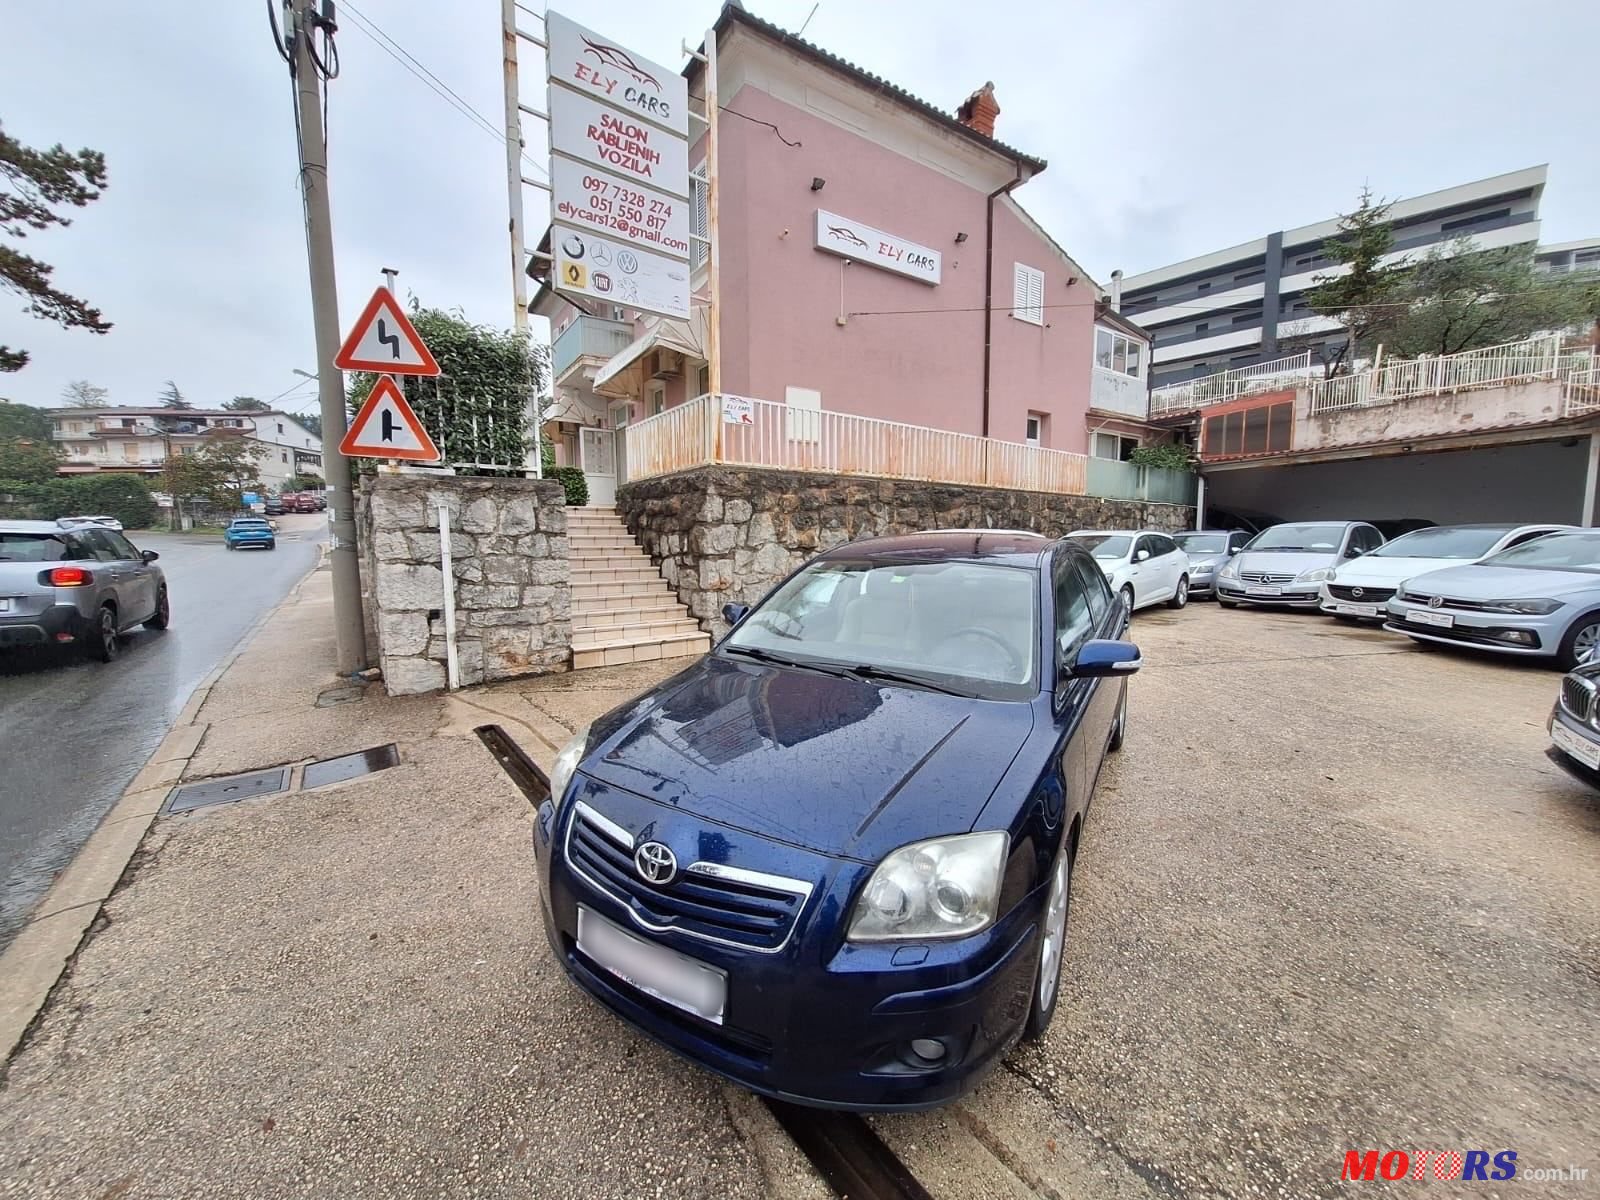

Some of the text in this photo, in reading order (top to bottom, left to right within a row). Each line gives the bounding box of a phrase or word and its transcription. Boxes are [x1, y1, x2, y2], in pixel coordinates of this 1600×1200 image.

[574, 62, 670, 119] ELY CARS
[587, 124, 660, 165] RABLJENIH
[600, 114, 648, 144] SALON
[598, 144, 652, 178] VOZILA
[582, 175, 672, 218] 097 7328 274
[590, 195, 666, 231] 051 550 817
[558, 201, 688, 251] elycars12@gmail.com
[878, 242, 935, 271] ELY CARS
